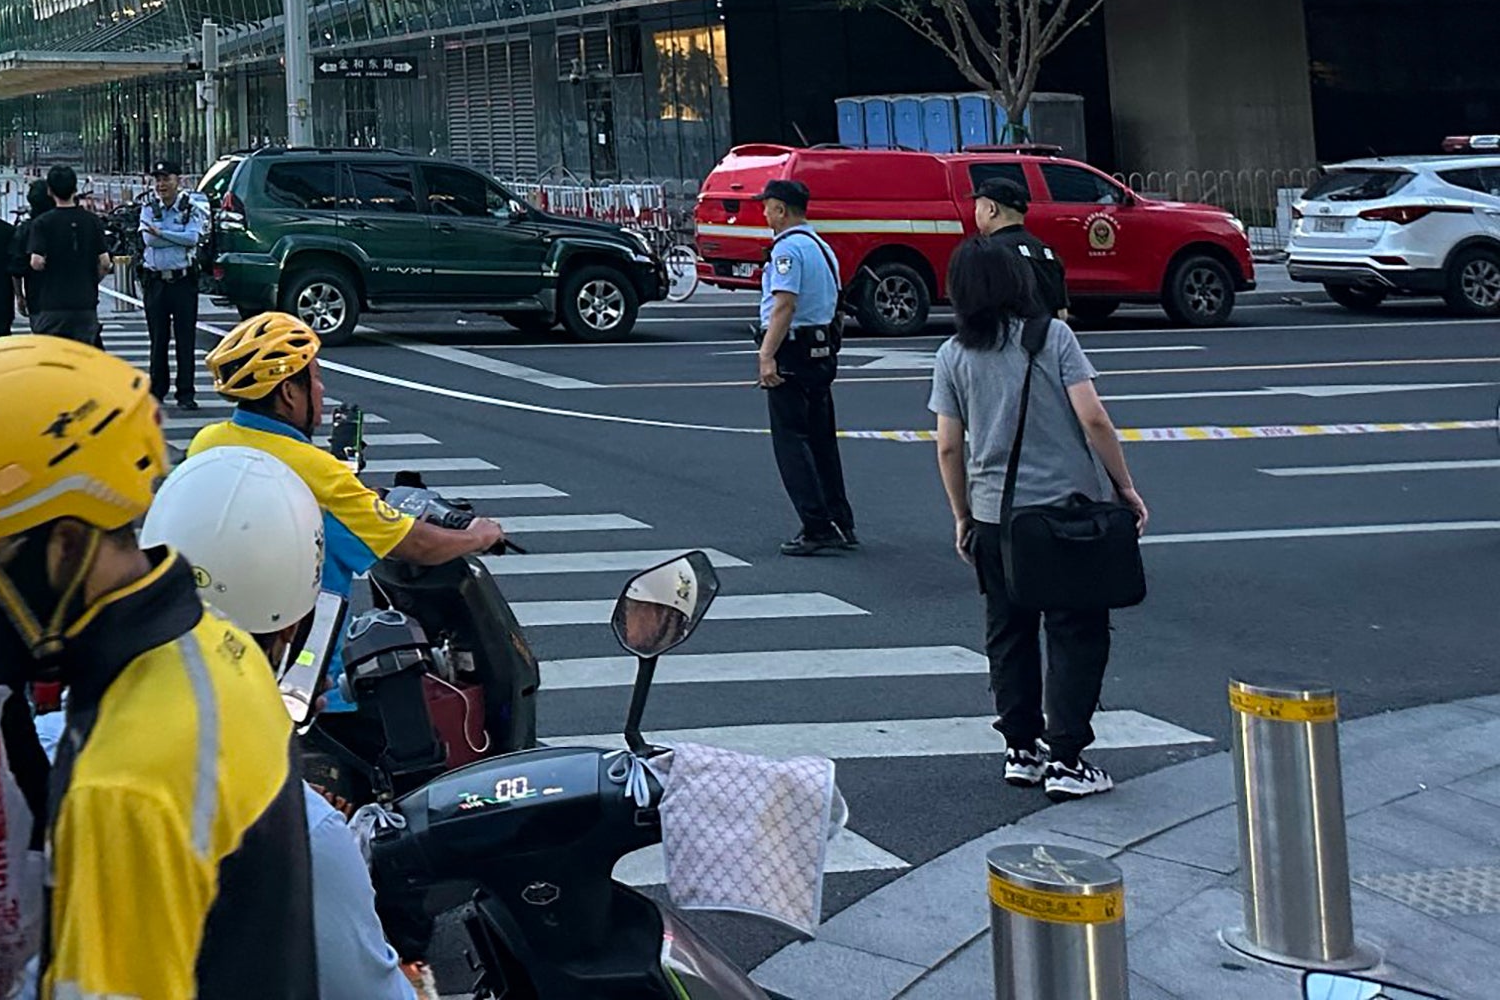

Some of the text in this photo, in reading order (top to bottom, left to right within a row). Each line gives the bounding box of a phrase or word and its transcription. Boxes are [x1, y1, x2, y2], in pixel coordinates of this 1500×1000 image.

[338, 58, 394, 70] 金和东路
[495, 776, 528, 800] 00
